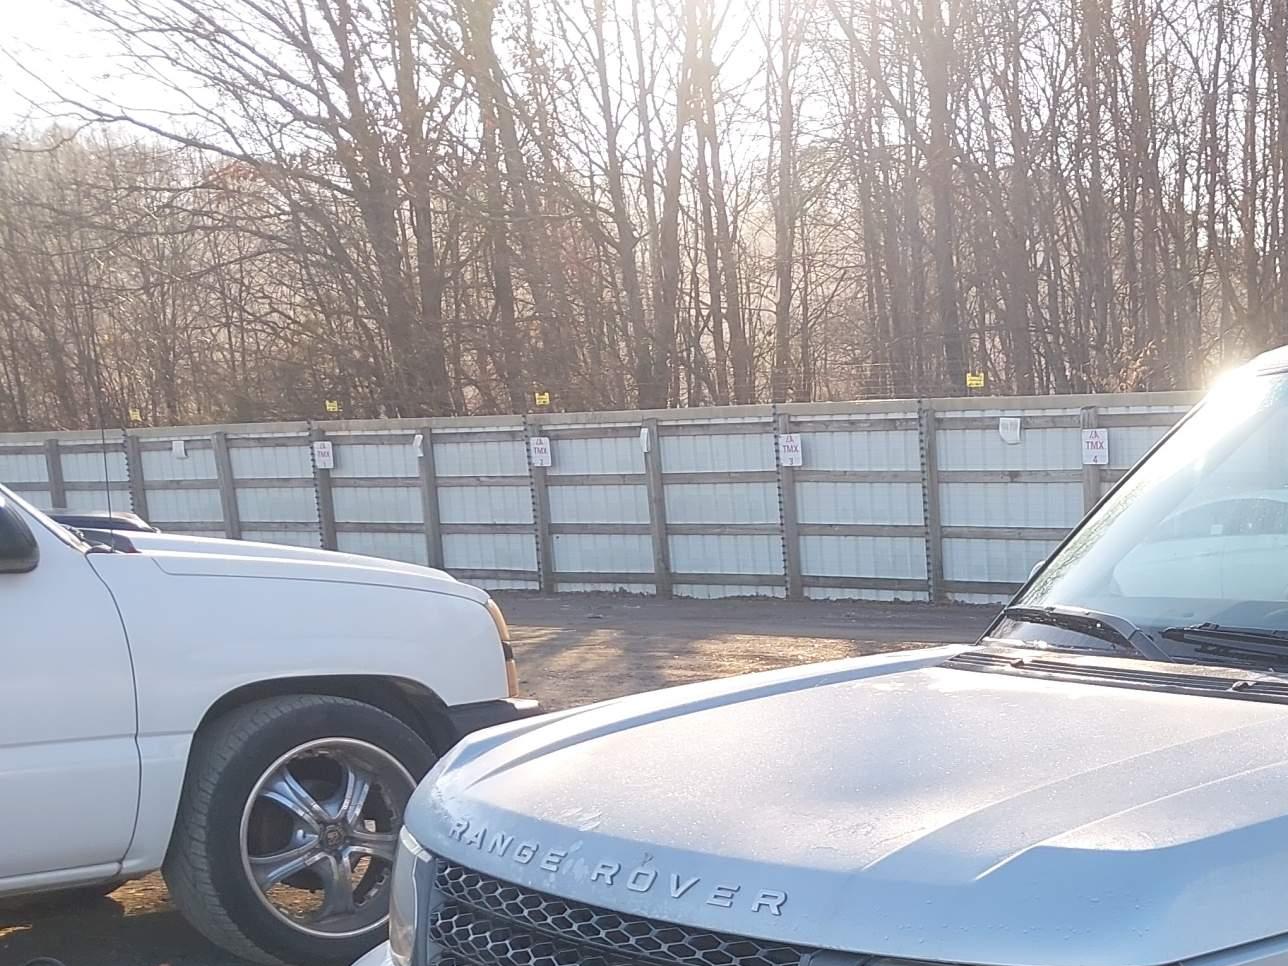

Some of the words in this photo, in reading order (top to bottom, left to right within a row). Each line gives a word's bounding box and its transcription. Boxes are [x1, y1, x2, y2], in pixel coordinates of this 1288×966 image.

[782, 444, 799, 454] TMX
[1085, 441, 1104, 450] TMX
[533, 446, 547, 455] TMX
[449, 819, 569, 873] RANGE
[590, 861, 790, 916] ROVER
